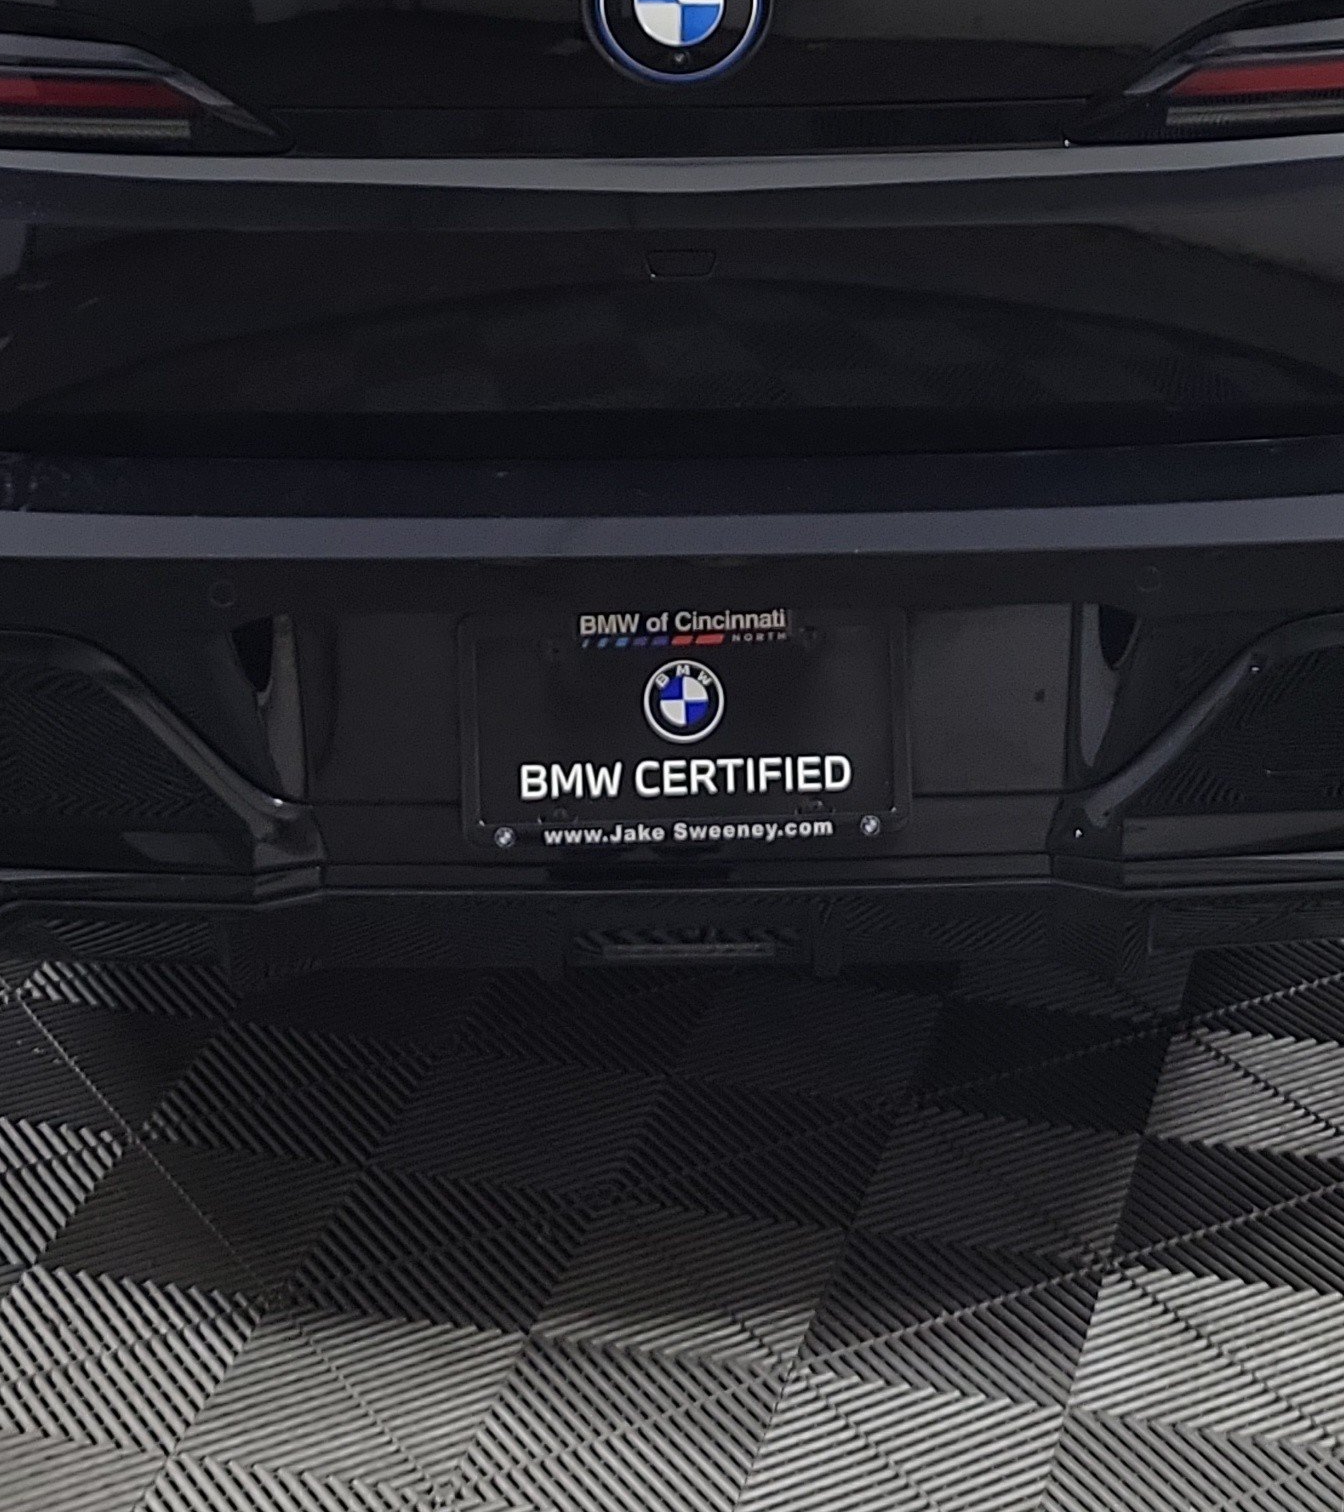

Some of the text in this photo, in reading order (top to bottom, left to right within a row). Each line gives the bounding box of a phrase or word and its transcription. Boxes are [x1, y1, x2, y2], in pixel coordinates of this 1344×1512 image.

[579, 608, 786, 635] BMW of Cincinnati
[731, 632, 787, 642] NORTH
[655, 664, 713, 688] BMW
[520, 754, 852, 800] BMW CERTIFIED
[543, 819, 834, 845] www.Jake Sweeney.com
